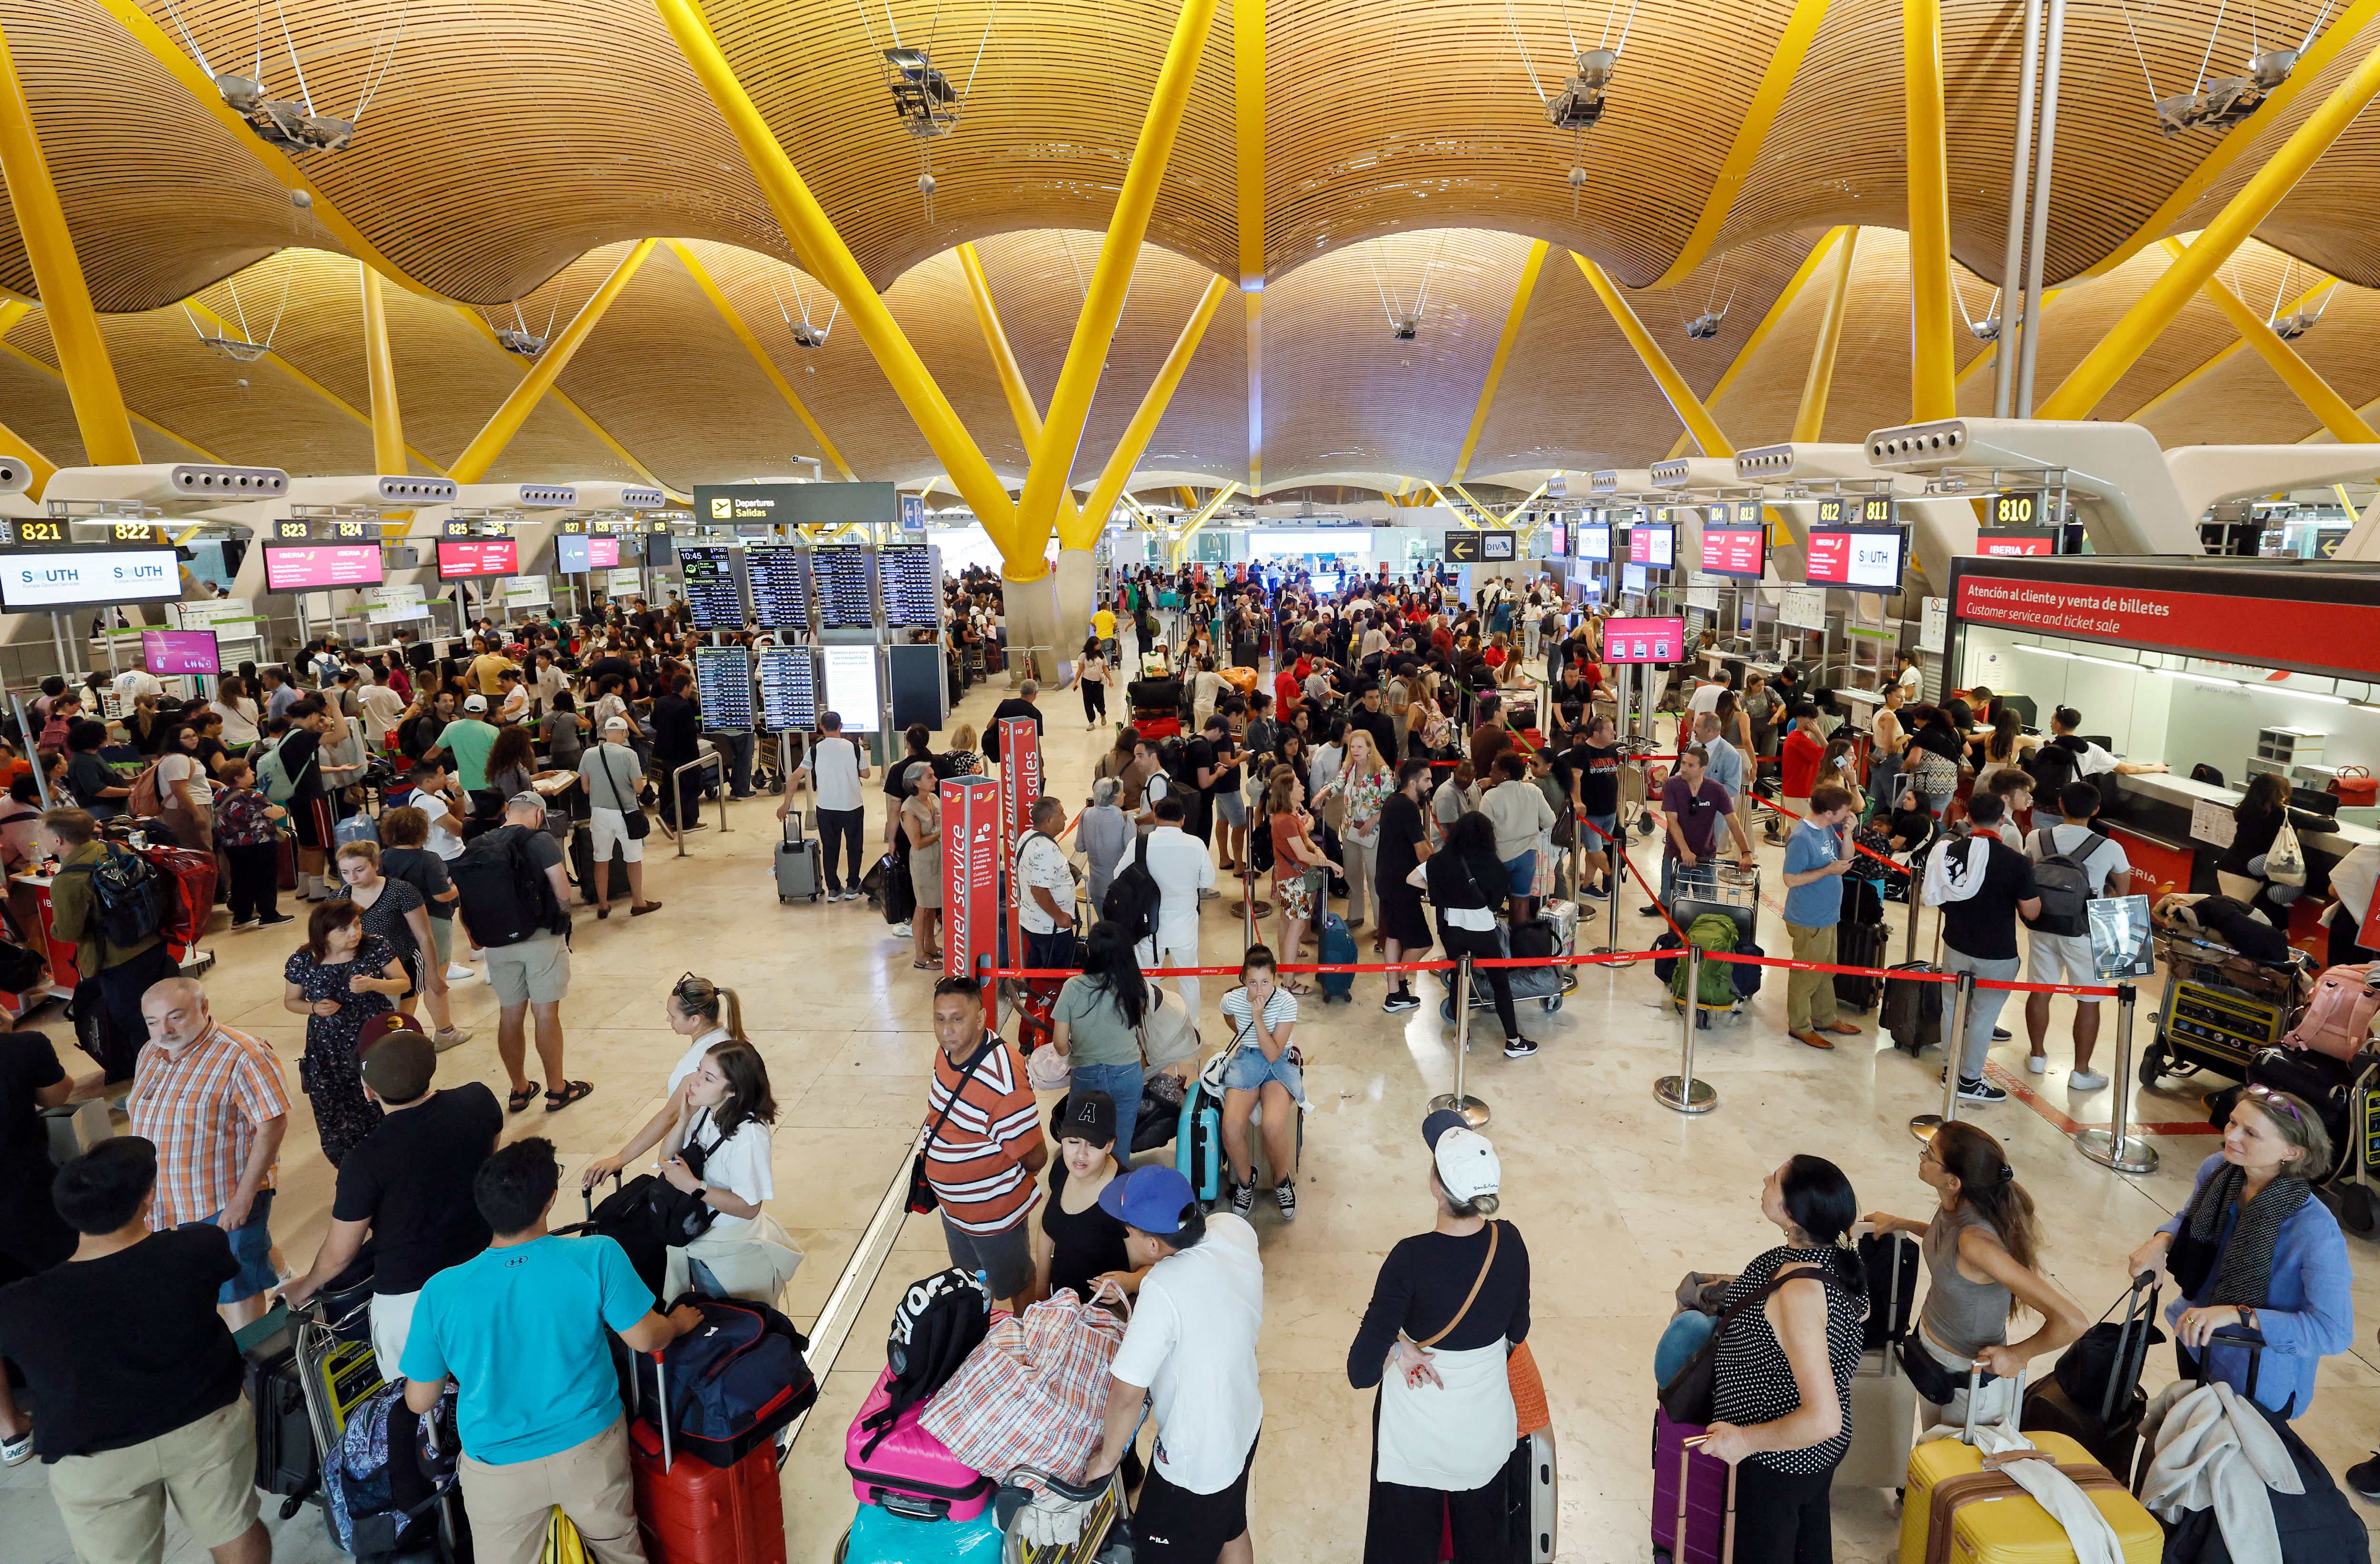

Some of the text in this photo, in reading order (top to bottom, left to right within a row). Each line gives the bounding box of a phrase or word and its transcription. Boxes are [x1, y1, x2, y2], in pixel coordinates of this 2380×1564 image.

[735, 499, 774, 508] Departures
[1866, 501, 1888, 520] 811
[1999, 498, 2032, 522] 810
[735, 508, 766, 517] Salidas
[1657, 508, 1667, 520] 815
[1711, 508, 1723, 521] 814
[1740, 507, 1754, 521] 813
[1821, 503, 1840, 520] 812
[21, 523, 61, 540] 821
[115, 525, 150, 539] 822
[281, 523, 307, 537] 823
[340, 524, 363, 536] 824
[448, 523, 468, 535] 825
[491, 523, 506, 534] 26
[565, 523, 579, 533] 827
[595, 523, 609, 532] 828
[654, 522, 666, 532] 829
[1990, 545, 2021, 555] IBERIA
[1968, 584, 2170, 617] Atención al cliente y venta de billetes
[1966, 602, 2120, 634] Customer service and ticket sale
[1022, 751, 1038, 797] sales
[1005, 753, 1018, 908] Venta de billetes
[950, 824, 964, 906] service
[1079, 1101, 1098, 1124] A
[349, 1347, 367, 1361] Trolley
[1149, 1534, 1169, 1544] FILA
